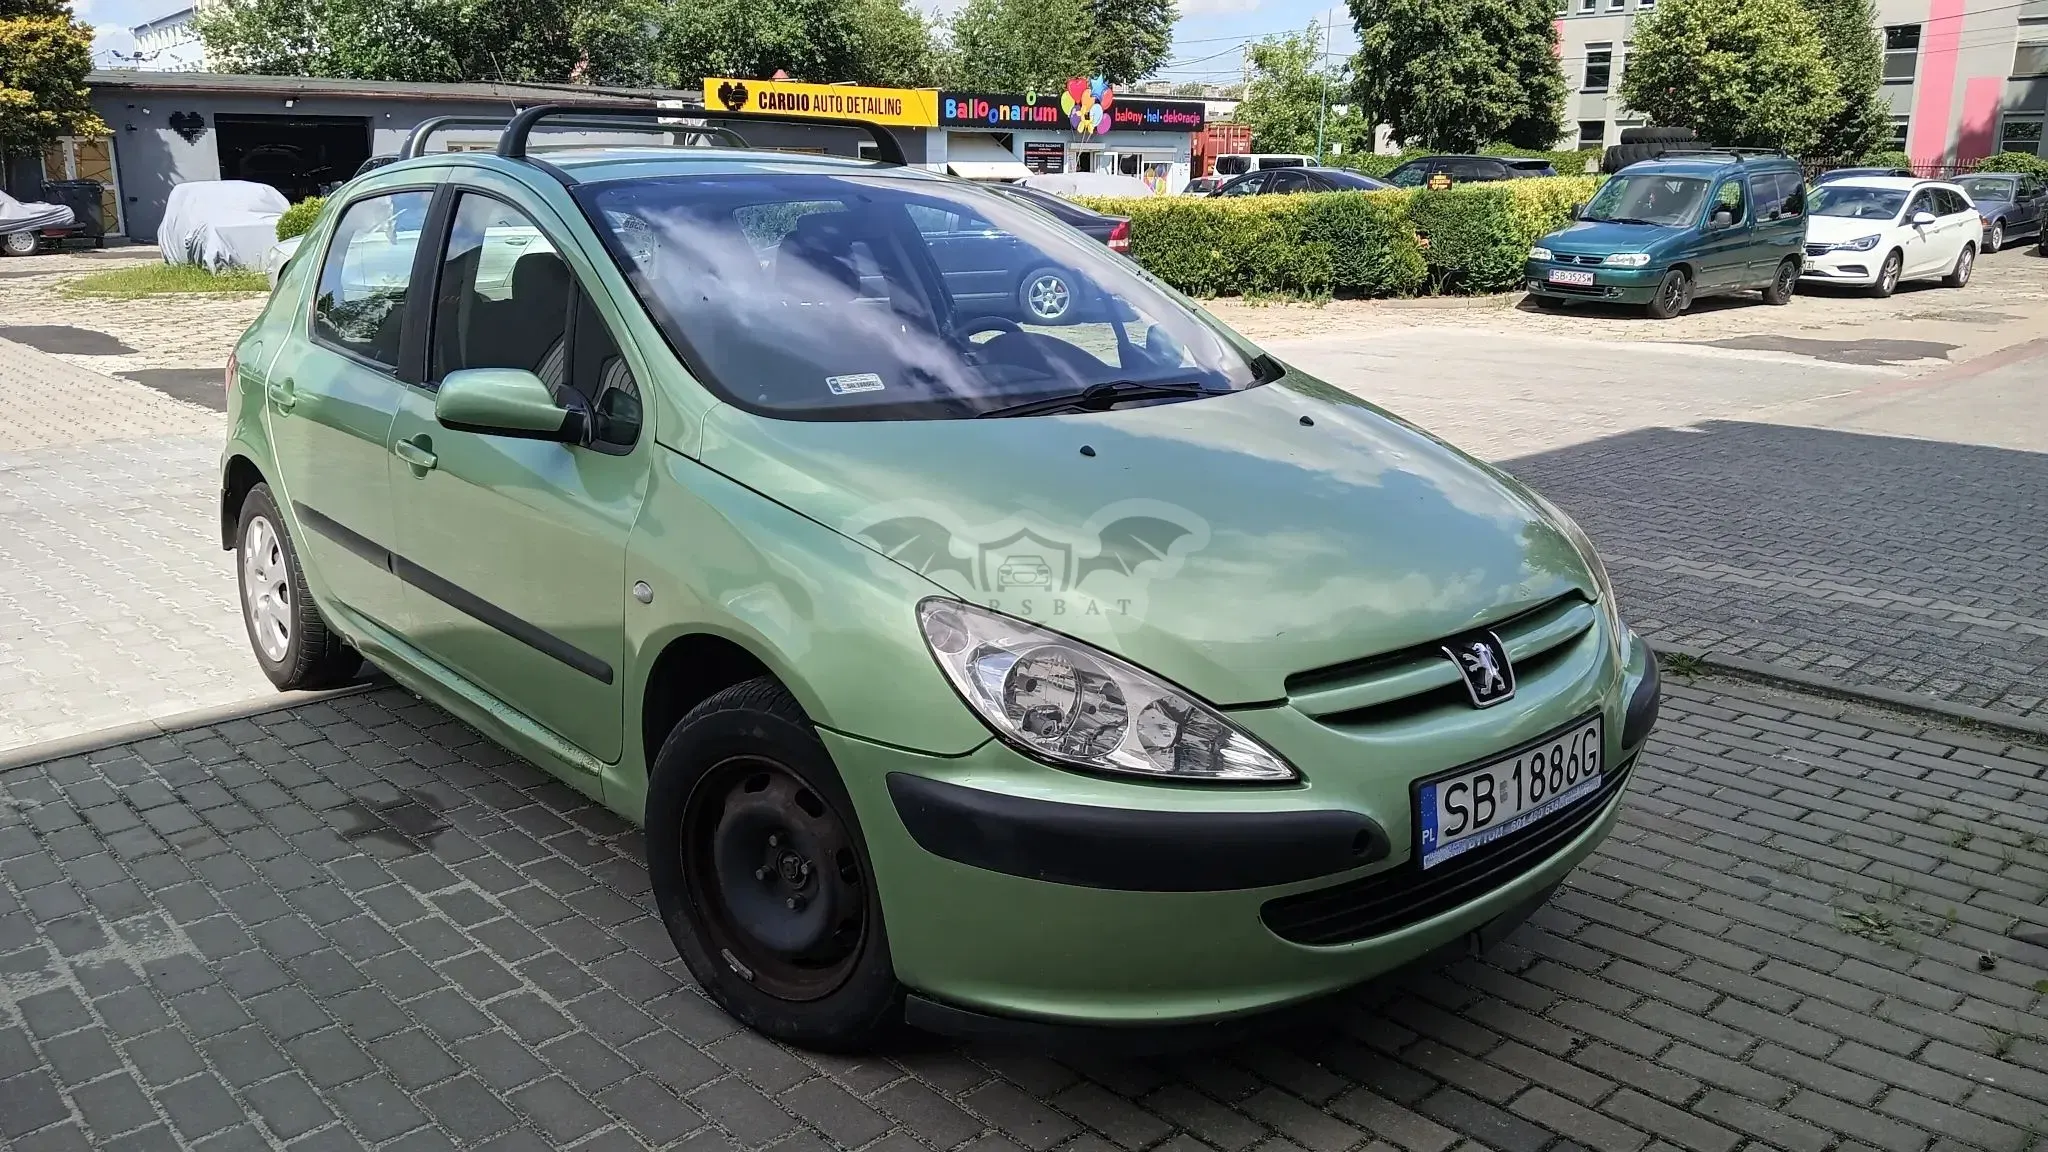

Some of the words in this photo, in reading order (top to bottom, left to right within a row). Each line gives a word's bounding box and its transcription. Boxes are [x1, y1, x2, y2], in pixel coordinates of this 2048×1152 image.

[759, 91, 809, 111] CARDIO
[813, 94, 843, 113] AUTO
[847, 97, 902, 116] DETAILING
[945, 89, 1058, 123] Balloonarium
[1444, 773, 1496, 837] SB
[1512, 727, 1597, 811] 1886G
[1422, 828, 1436, 845] PL
